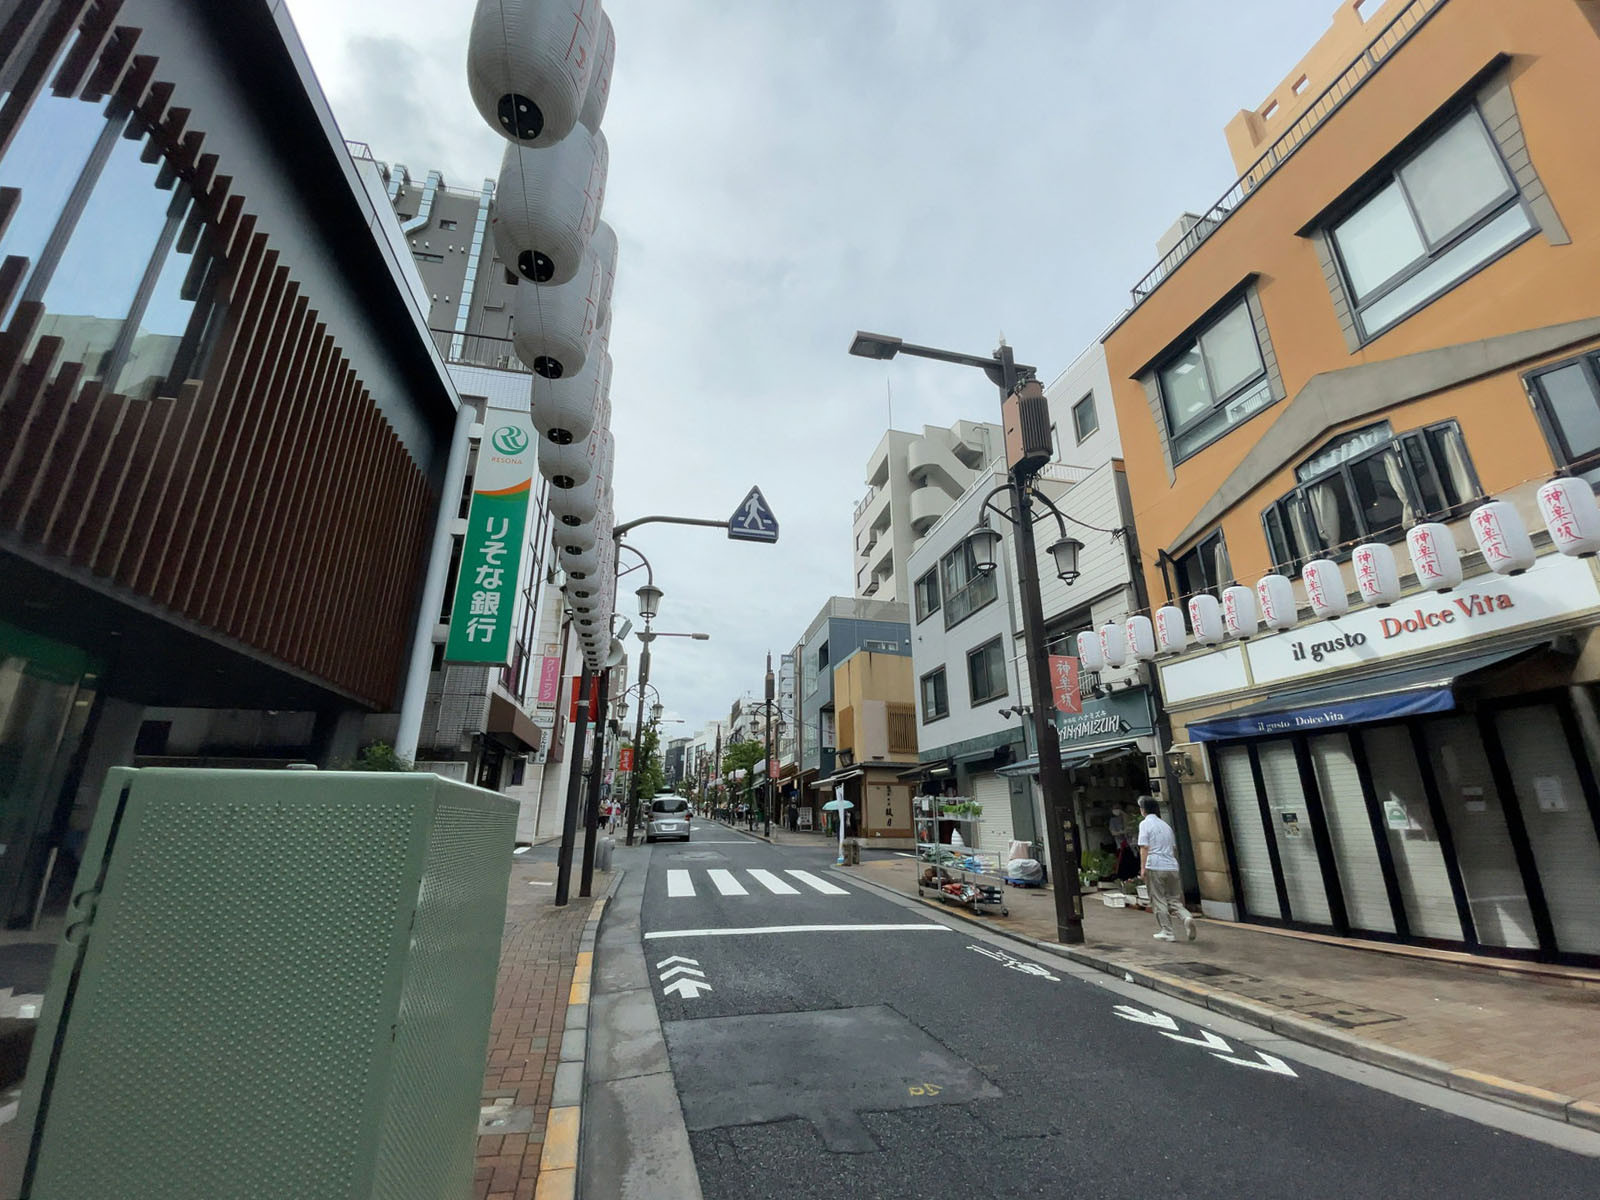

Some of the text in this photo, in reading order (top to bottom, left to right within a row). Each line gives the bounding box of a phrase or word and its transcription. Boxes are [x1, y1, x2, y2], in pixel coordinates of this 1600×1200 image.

[491, 457, 523, 465] RESONA
[1475, 510, 1512, 563] 神楽坂
[1544, 487, 1584, 545] 神楽坂
[466, 516, 509, 643] りそな銀行
[1357, 551, 1383, 597] 神楽坂
[1413, 529, 1443, 580] 神楽坂
[1291, 593, 1514, 662] il gusto Dolce Vita
[543, 659, 555, 700] クリーニング
[1055, 660, 1078, 711] 神楽坂
[1057, 715, 1120, 742] ANAMIZUKI
[1258, 711, 1344, 732] il gusto Dolce Vita
